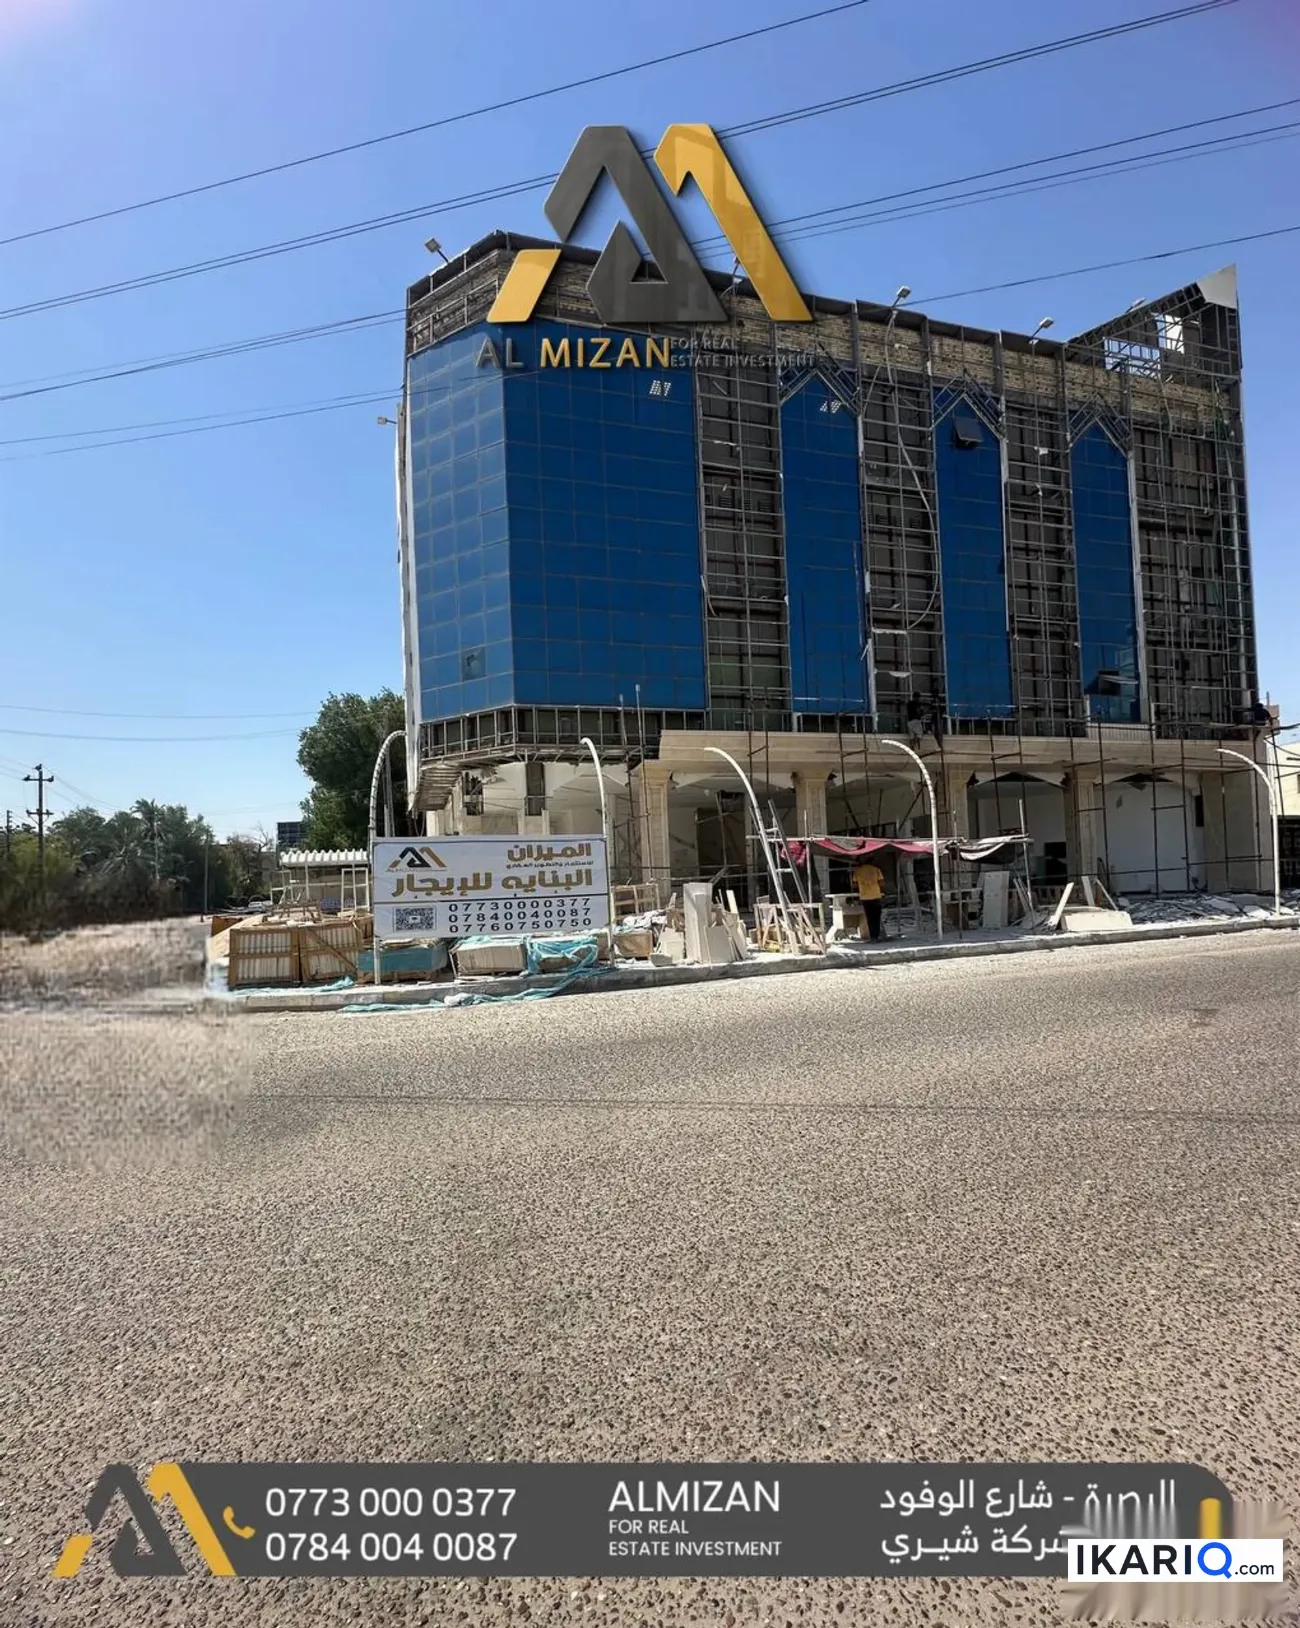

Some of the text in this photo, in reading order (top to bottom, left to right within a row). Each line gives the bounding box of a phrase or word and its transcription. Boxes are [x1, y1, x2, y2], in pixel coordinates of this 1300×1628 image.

[507, 843, 592, 862] الميزان
[449, 898, 591, 913] 07730000377
[449, 908, 591, 923] 07840040087
[449, 918, 592, 933] 07760750750
